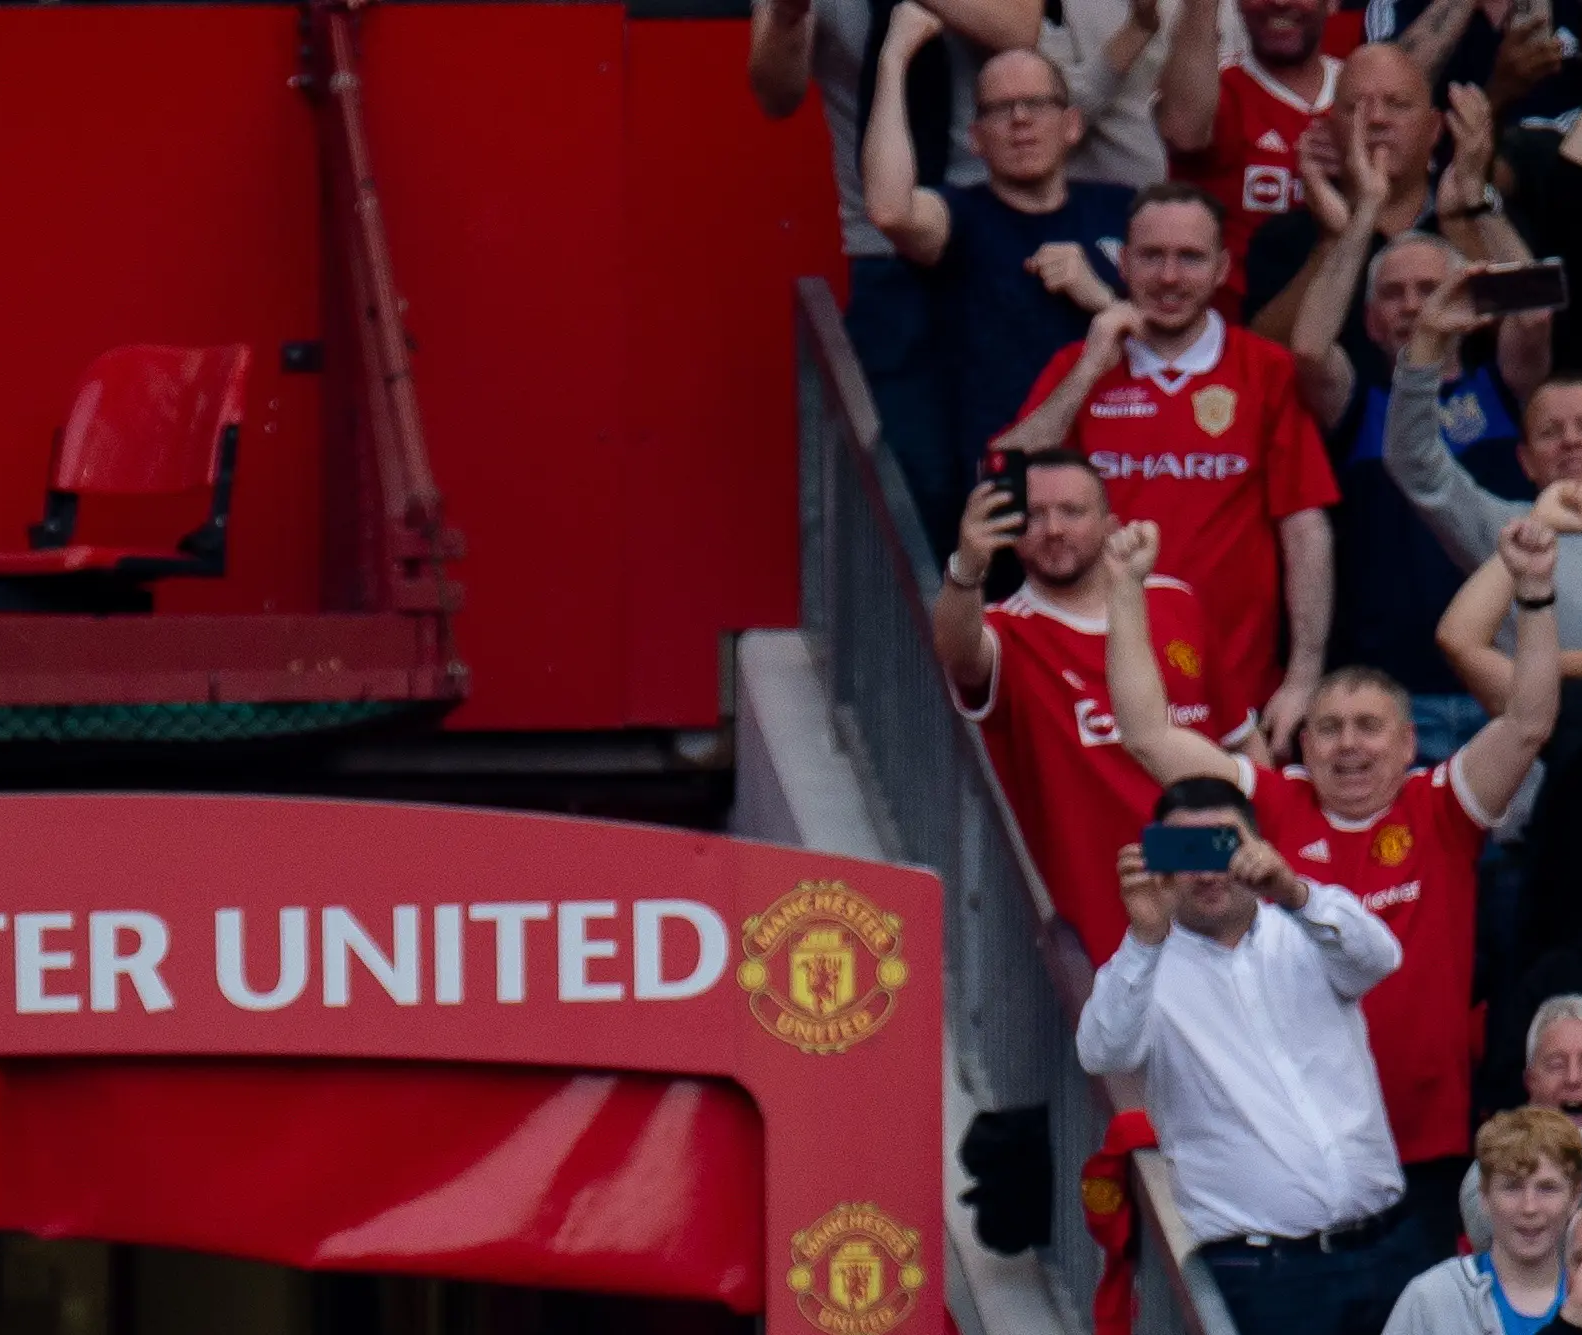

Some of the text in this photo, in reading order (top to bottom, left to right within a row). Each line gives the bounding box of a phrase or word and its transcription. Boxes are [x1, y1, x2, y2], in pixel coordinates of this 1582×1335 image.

[1088, 450, 1250, 480] SHARP
[753, 893, 891, 951] MANCHESTER
[214, 898, 730, 1011] UNITED
[776, 1011, 872, 1039] UNITED
